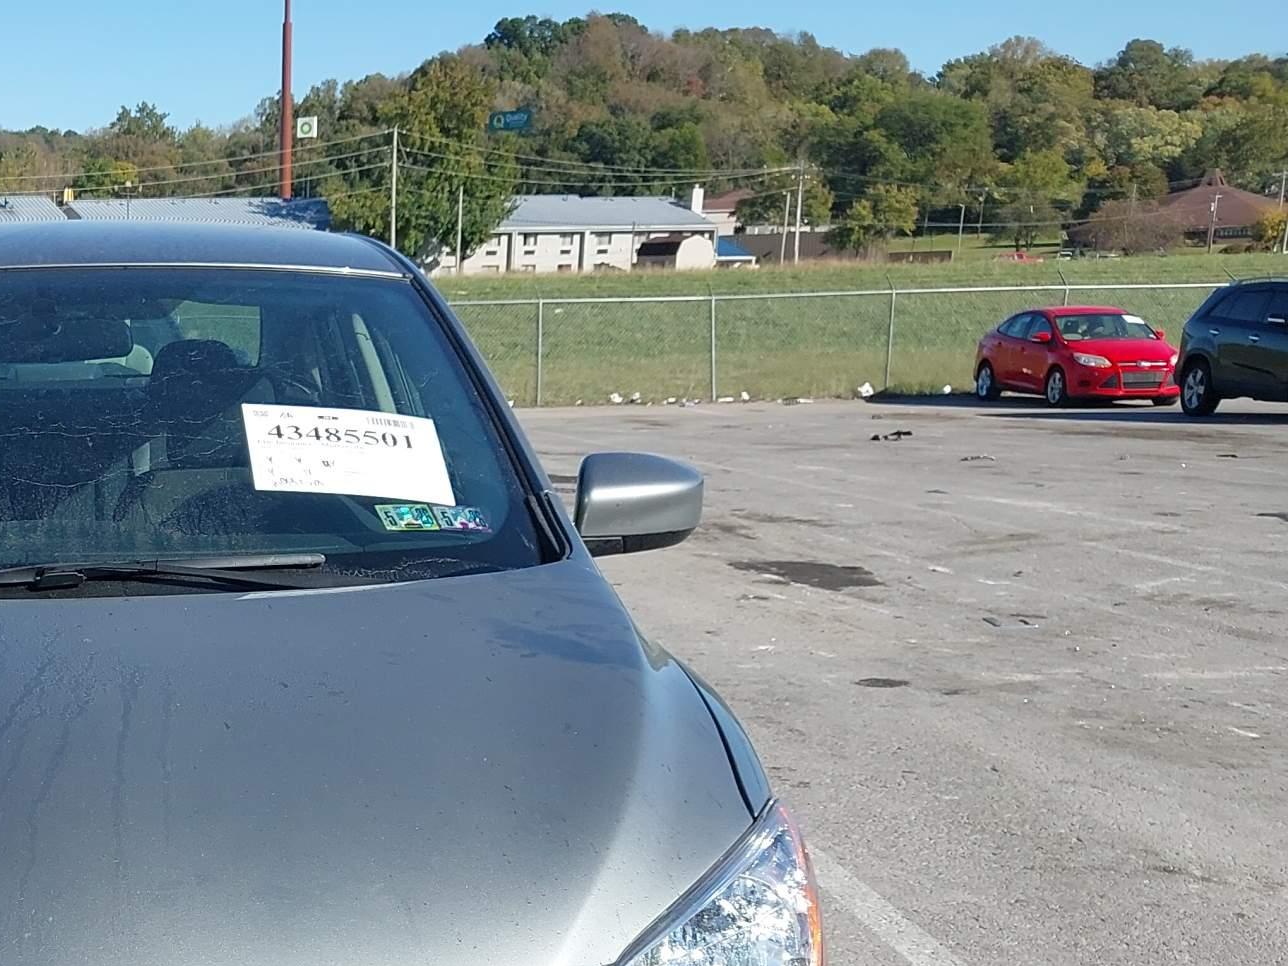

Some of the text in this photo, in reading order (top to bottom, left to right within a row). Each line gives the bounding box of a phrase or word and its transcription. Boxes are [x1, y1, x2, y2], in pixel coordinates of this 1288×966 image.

[267, 423, 414, 449] 43485501
[384, 510, 398, 527] 5
[440, 510, 454, 527] 5
